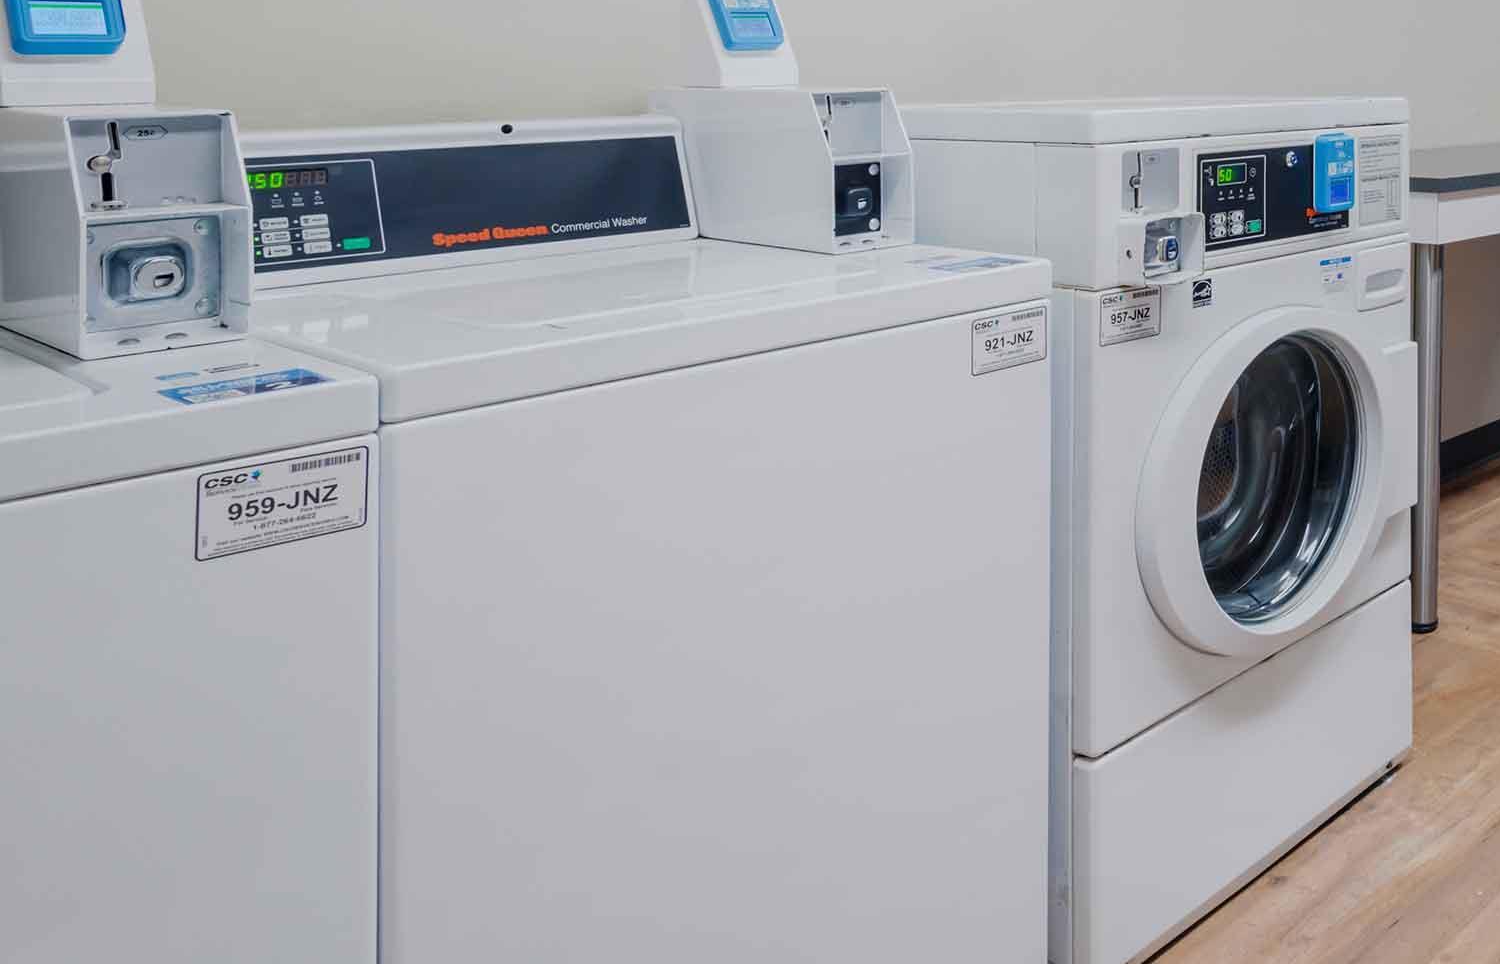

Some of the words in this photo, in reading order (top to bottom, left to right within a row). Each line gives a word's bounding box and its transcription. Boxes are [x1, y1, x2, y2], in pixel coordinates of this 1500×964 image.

[432, 228, 490, 248] Speed
[493, 225, 548, 240] Queen
[551, 219, 610, 234] Commercial
[612, 215, 648, 228] Washer
[974, 320, 993, 331] CSC
[1110, 307, 1151, 325] 957-JNZ
[984, 330, 1033, 352] 921-JNZ
[204, 473, 249, 490] CSC
[228, 484, 339, 521] 959-JNZ
